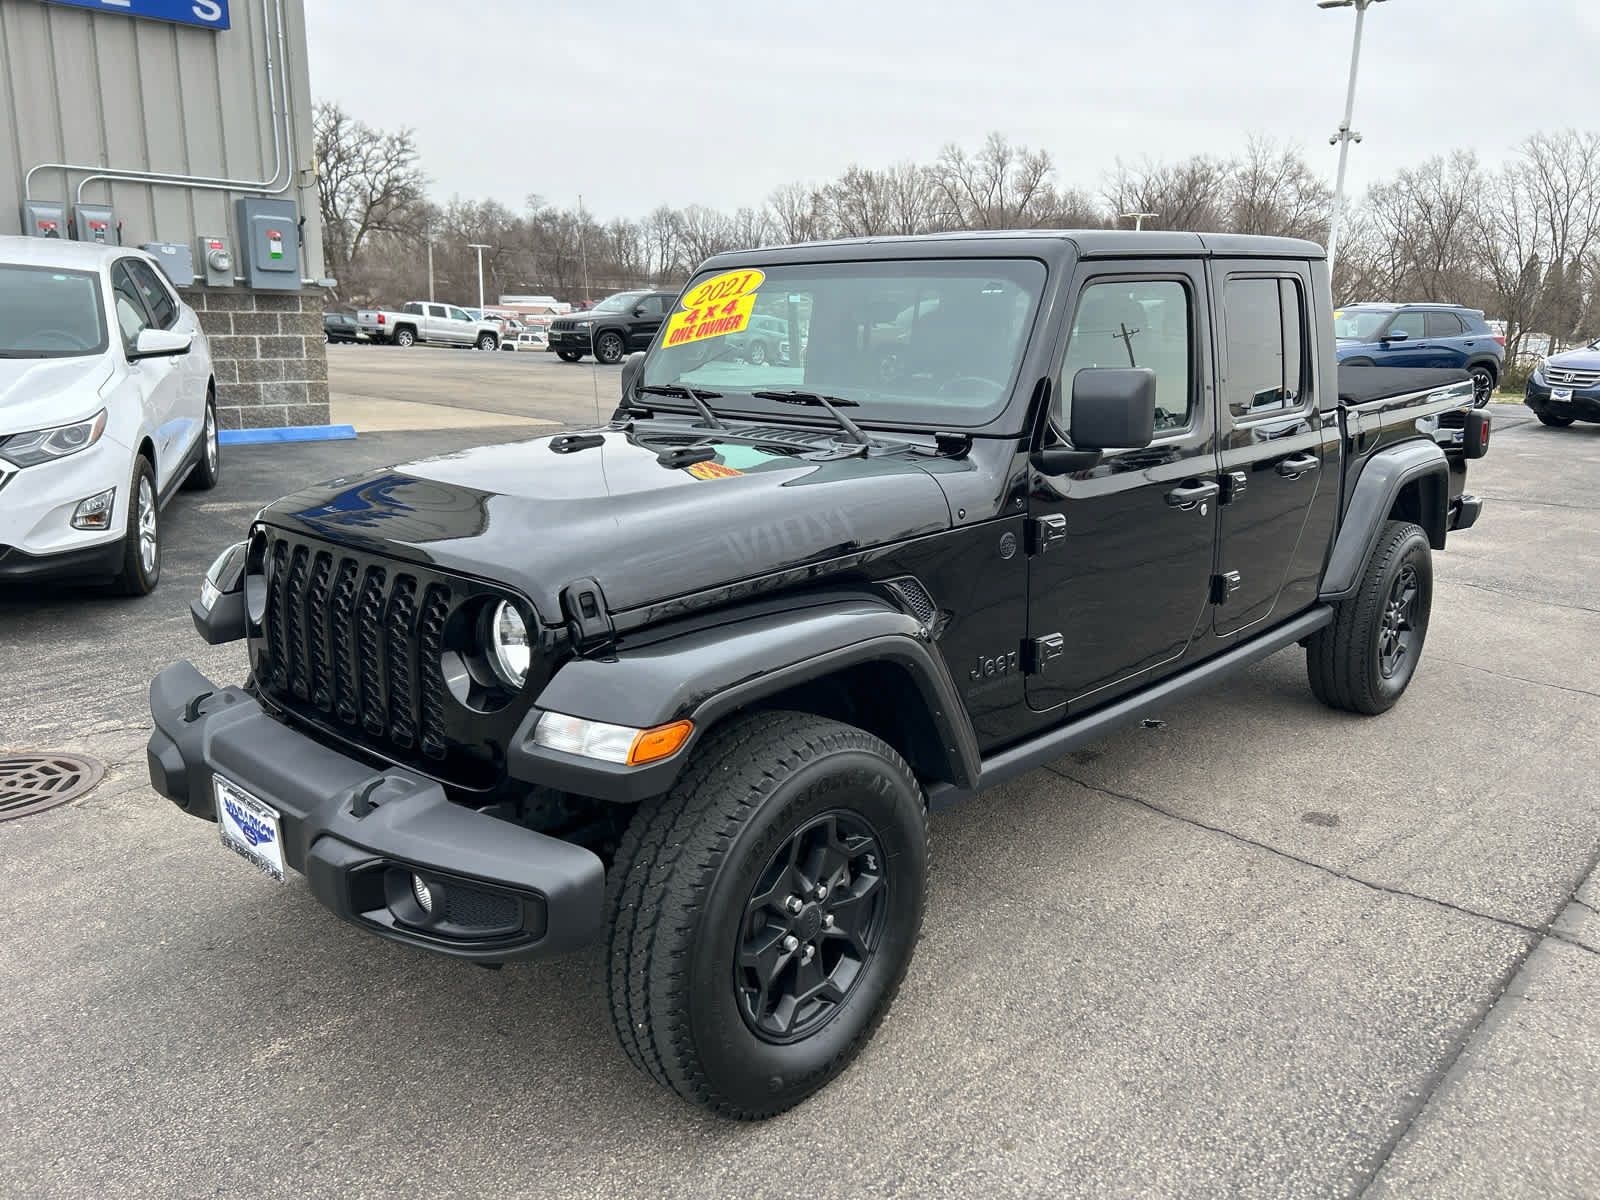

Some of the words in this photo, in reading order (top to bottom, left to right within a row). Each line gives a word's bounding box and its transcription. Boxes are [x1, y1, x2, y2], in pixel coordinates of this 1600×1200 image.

[693, 273, 753, 307] 2021
[669, 325, 697, 345] ONE
[696, 313, 744, 339] OWNER
[969, 649, 1016, 682] Jeep
